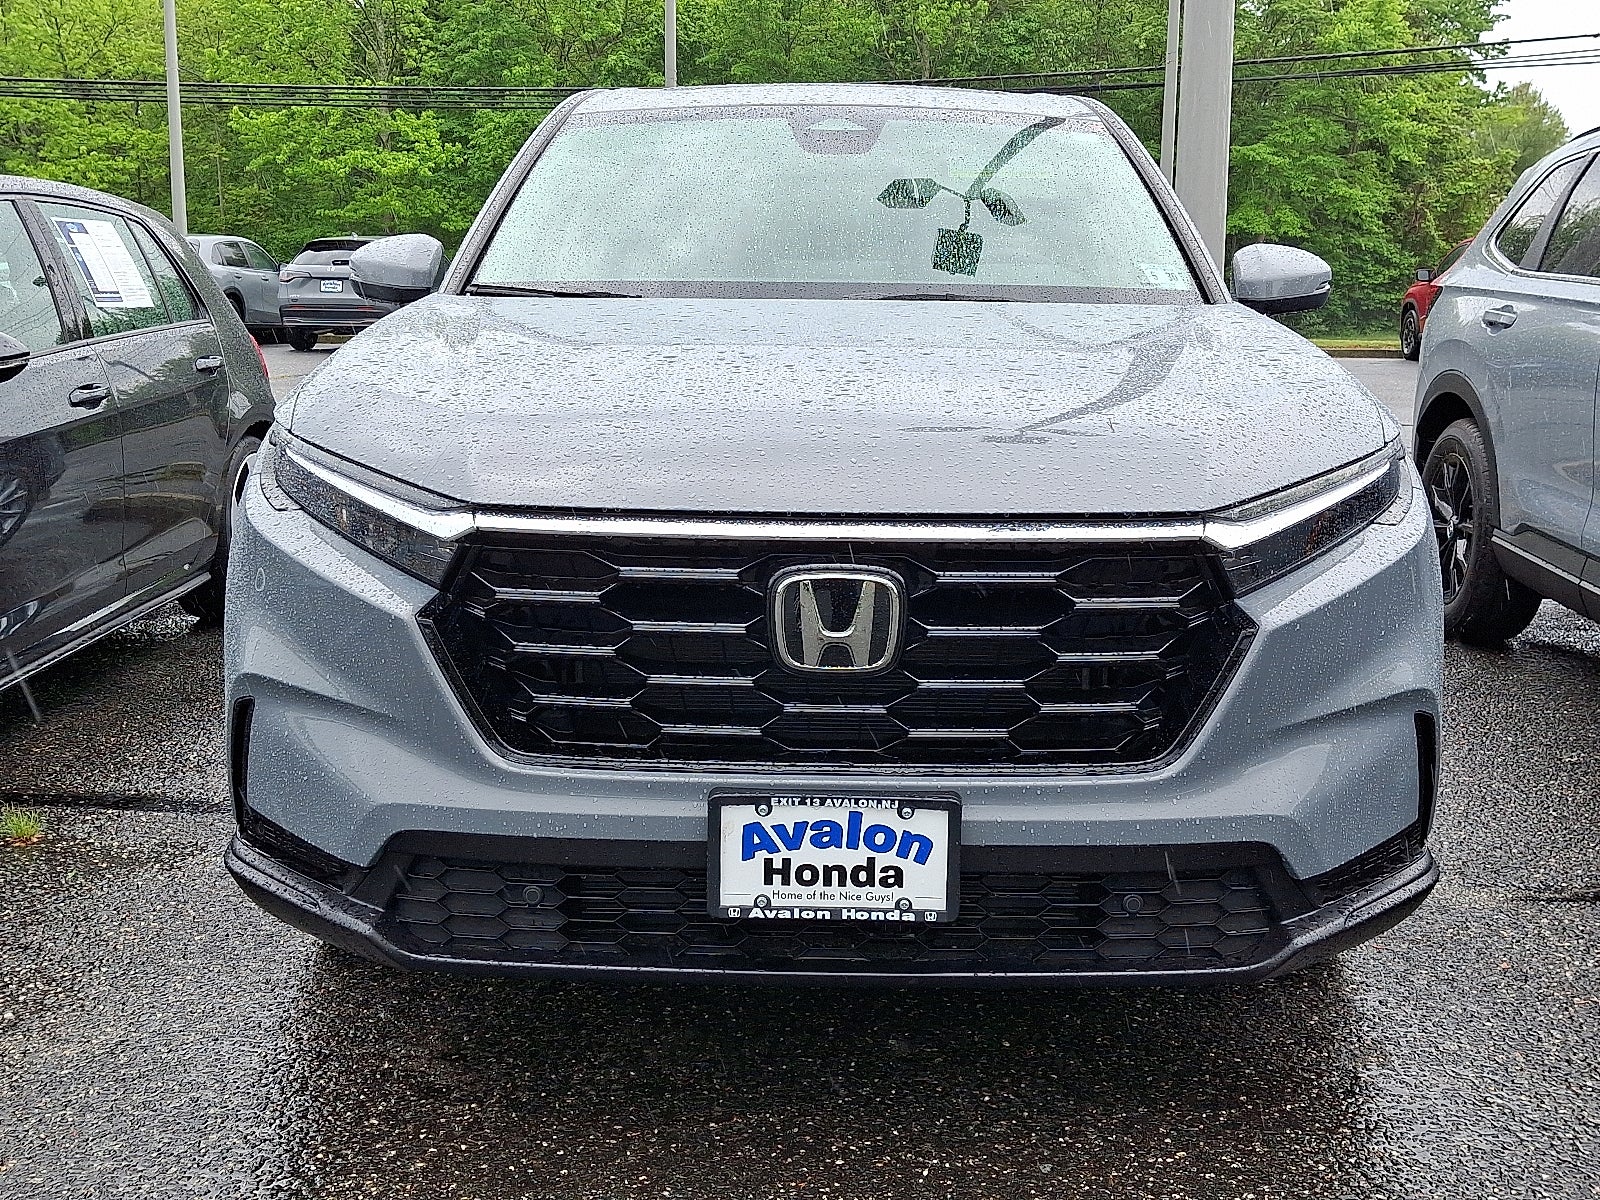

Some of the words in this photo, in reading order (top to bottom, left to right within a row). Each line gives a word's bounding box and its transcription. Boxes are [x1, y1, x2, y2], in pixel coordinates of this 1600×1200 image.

[770, 797, 801, 806] EXIT
[805, 798, 820, 807] 13
[741, 810, 934, 866] Avalon
[763, 857, 904, 888] Honda
[772, 890, 803, 900] Home
[806, 890, 817, 900] of
[819, 890, 836, 901] the
[839, 891, 862, 901] Nice
[865, 891, 894, 903] Guys!
[748, 908, 831, 920] Avalon
[841, 908, 917, 922] Honda
